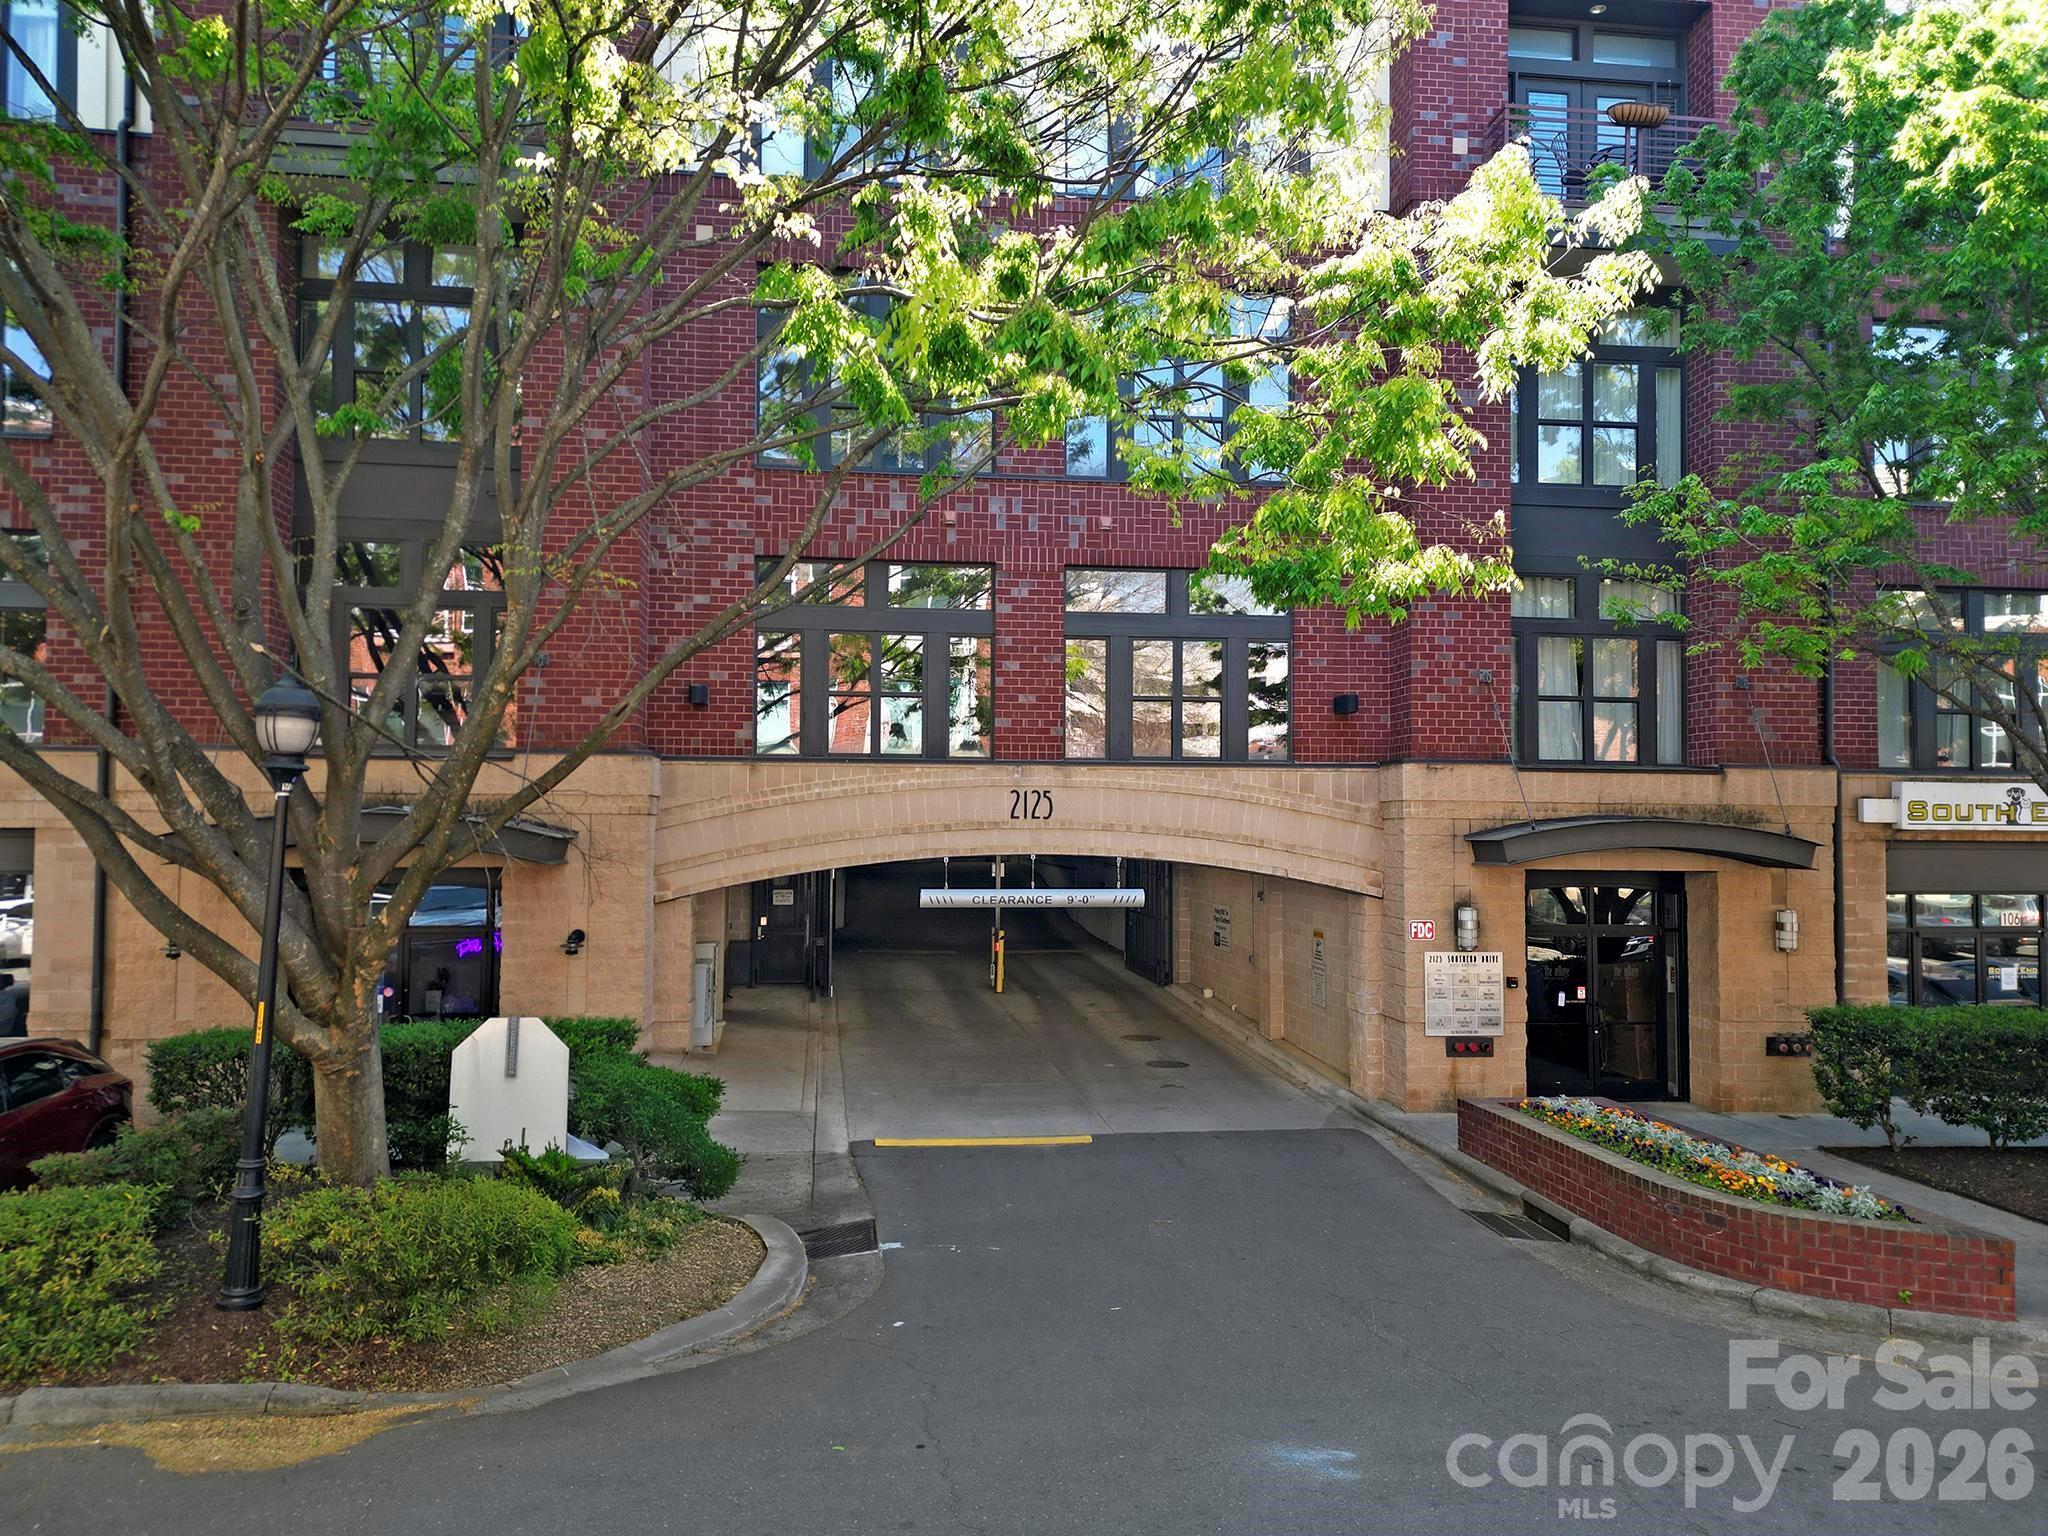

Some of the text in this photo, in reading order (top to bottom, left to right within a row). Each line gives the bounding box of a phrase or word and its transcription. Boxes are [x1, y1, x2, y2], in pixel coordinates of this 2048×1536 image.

[1010, 790, 1053, 820] 2125
[1907, 800, 2016, 822] SOUTH
[972, 895, 1053, 905] CLEARANCE
[2003, 912, 2020, 926] 106
[1411, 923, 1433, 938] FDC
[1429, 955, 1499, 963] 2125 SOUTHEND DRIVE
